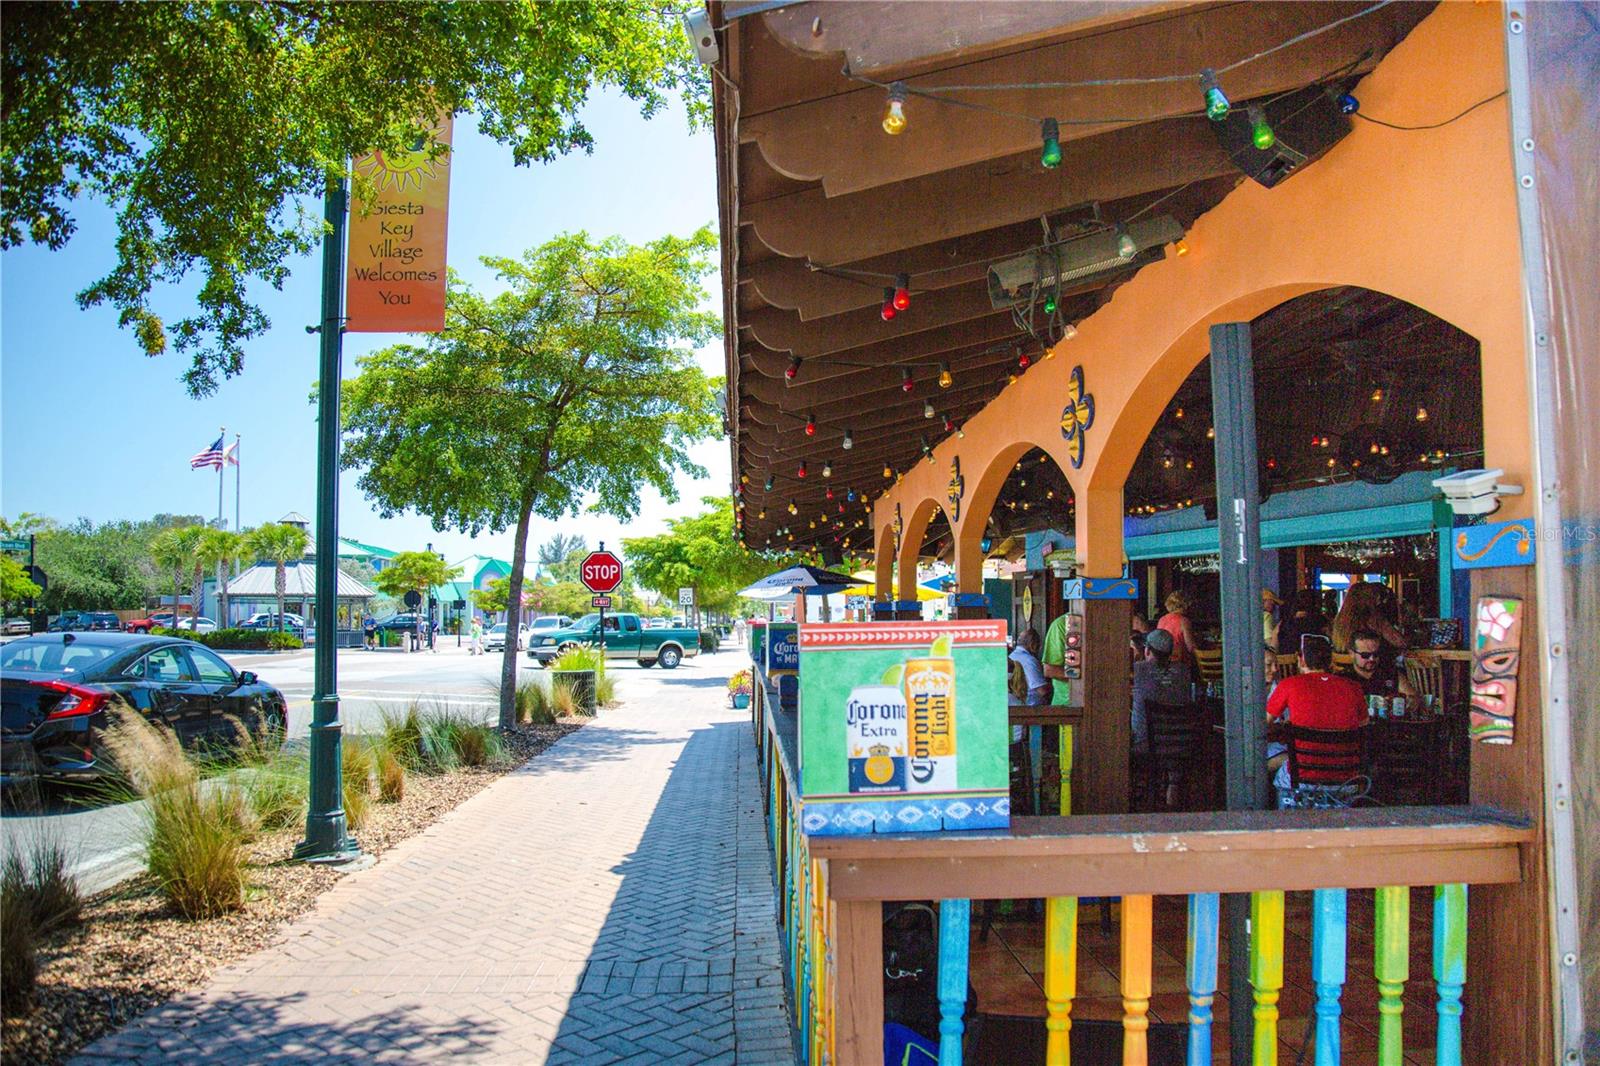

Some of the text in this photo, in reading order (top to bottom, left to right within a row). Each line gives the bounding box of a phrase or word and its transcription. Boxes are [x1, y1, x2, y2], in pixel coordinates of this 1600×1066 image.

[373, 200, 424, 215] Siesta
[380, 221, 414, 242] Key
[369, 239, 423, 264] Village
[354, 262, 438, 281] Welcomes
[379, 291, 411, 305] You
[585, 565, 618, 580] STOP
[931, 694, 950, 739] Light
[861, 723, 898, 737] Extra
[911, 693, 937, 784] Corona
